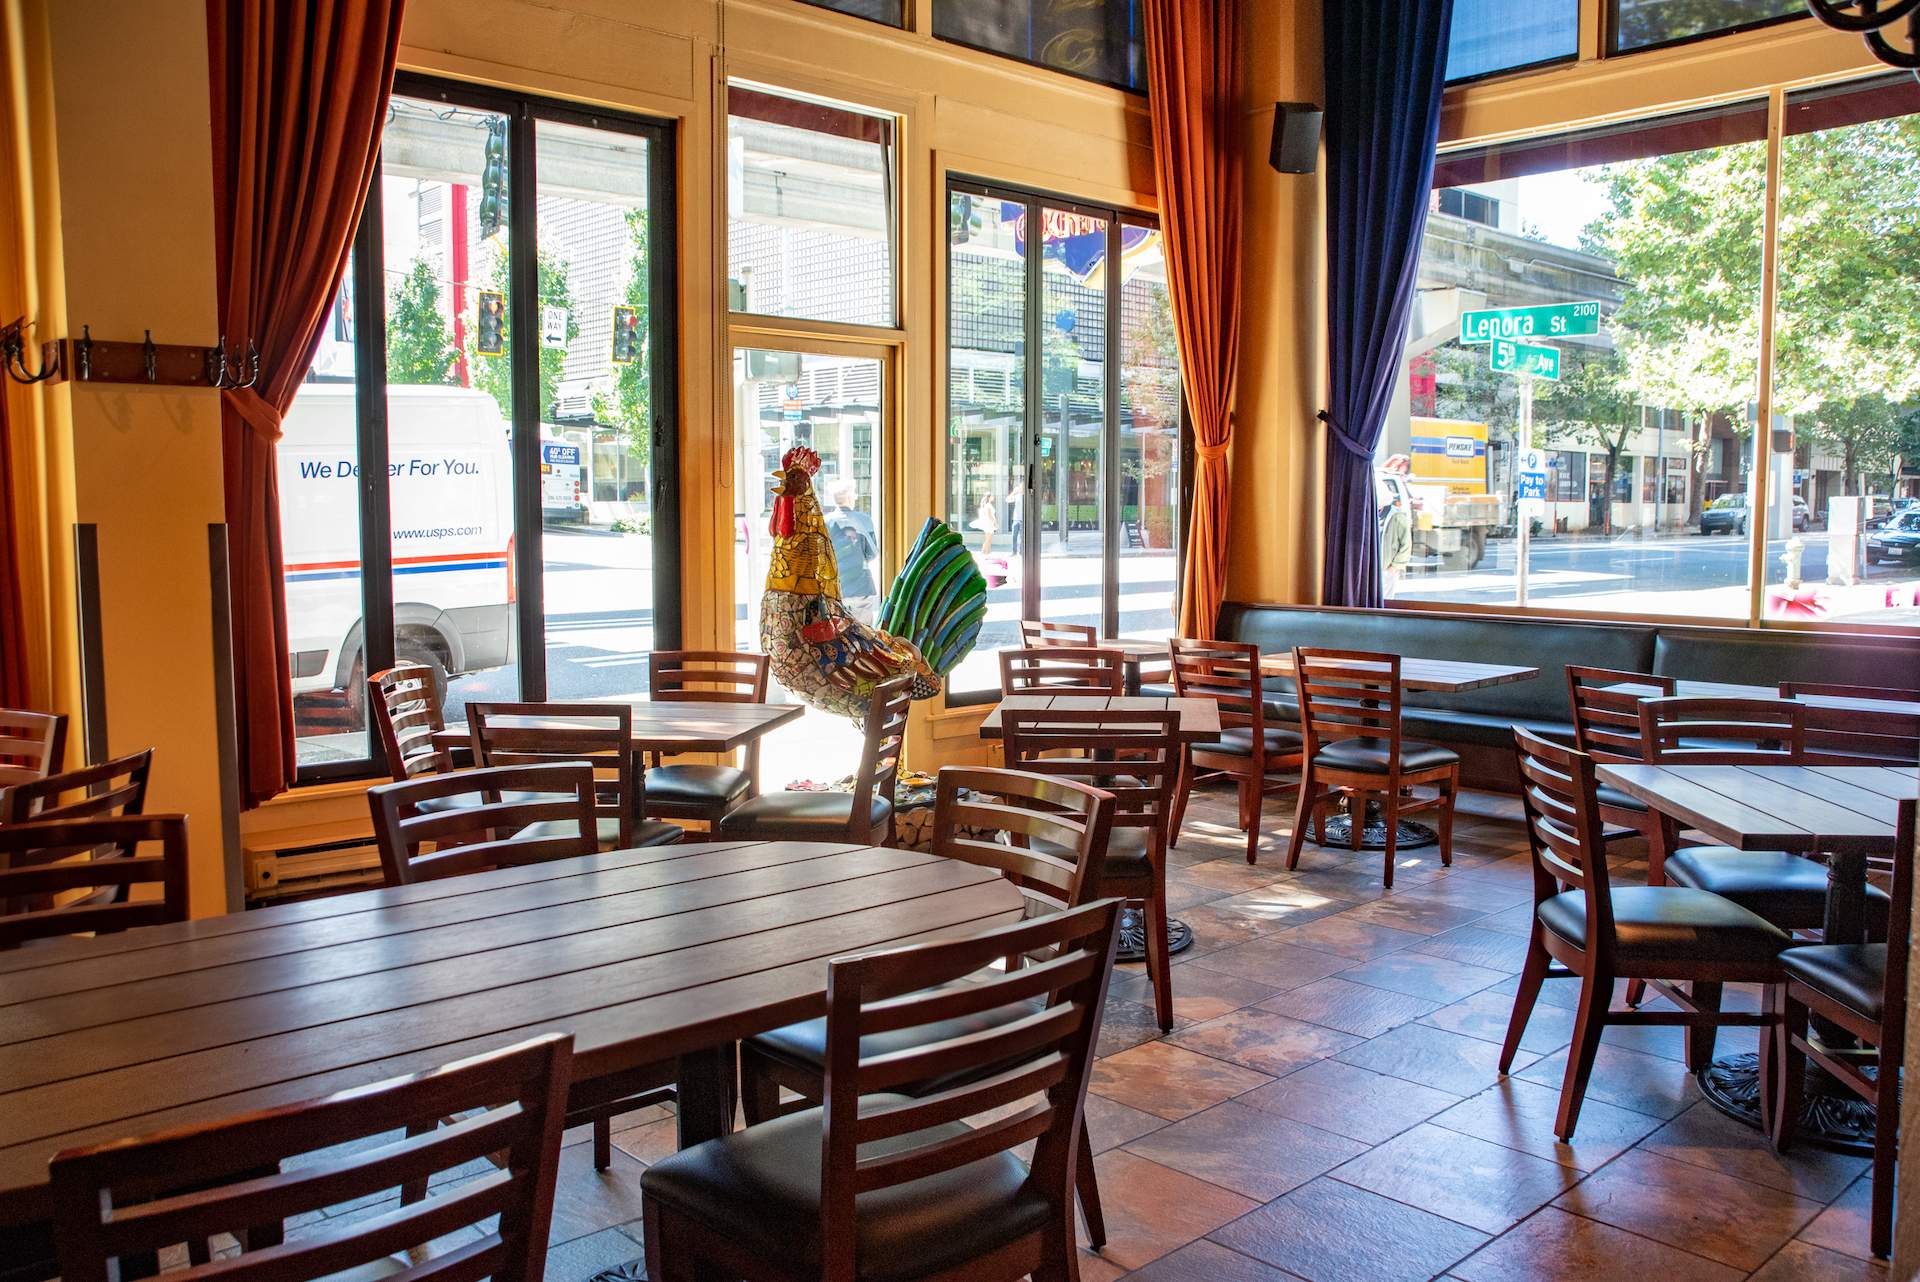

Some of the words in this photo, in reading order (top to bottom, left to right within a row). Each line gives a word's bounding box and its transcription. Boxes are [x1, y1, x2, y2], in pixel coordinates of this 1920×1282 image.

[547, 311, 563, 321] ONE
[1573, 304, 1597, 317] 2100
[547, 322, 562, 331] WAY
[1466, 314, 1534, 338] Lenora
[1550, 316, 1567, 333] St
[1497, 342, 1516, 367] 5th
[1536, 354, 1554, 373] Ave
[1448, 442, 1473, 452] PENSKE
[300, 461, 332, 479] We
[337, 461, 404, 478] Deer
[409, 459, 440, 476] For
[443, 458, 480, 475] You.
[1520, 474, 1534, 487] Pay
[1535, 475, 1544, 484] to
[1523, 486, 1541, 497] Park
[393, 526, 482, 540] www.usps.com
